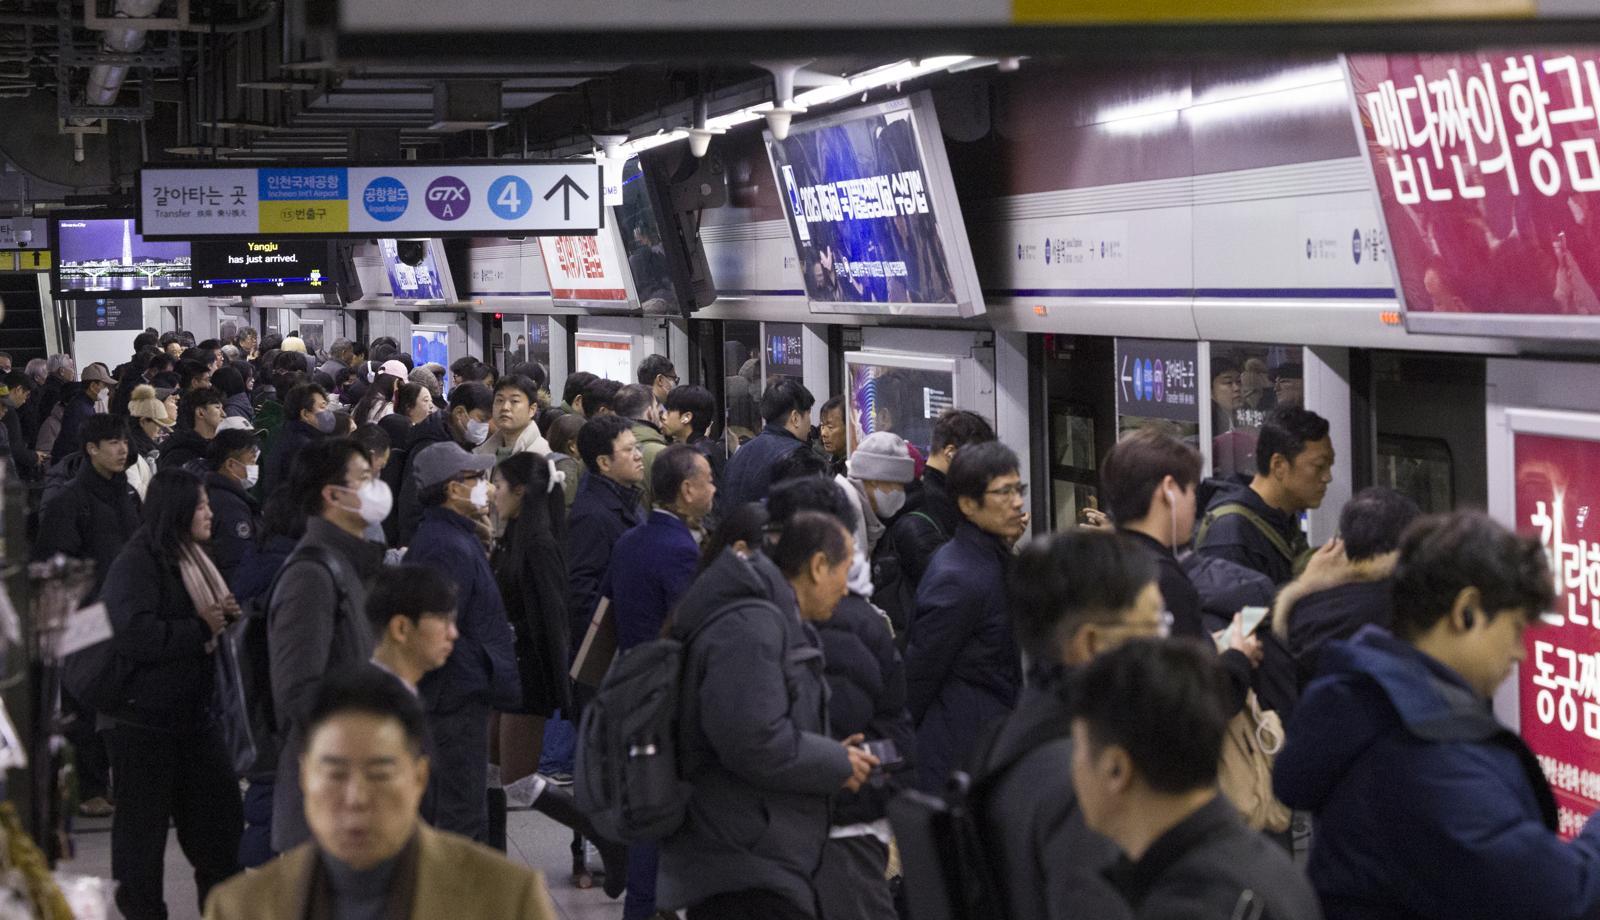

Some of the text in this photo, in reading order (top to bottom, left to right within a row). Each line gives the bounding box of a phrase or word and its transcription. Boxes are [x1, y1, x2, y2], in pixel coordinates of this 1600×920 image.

[1365, 62, 1519, 205] 맵단짠의
[267, 175, 339, 189] 인천국제공항
[153, 186, 247, 206] 갈아타는 곳
[314, 190, 339, 199] Airport
[365, 188, 408, 202] 공항철도
[428, 187, 465, 201] GTX
[496, 181, 521, 213] 4
[155, 209, 191, 218] Transfer
[442, 203, 454, 217] A
[248, 242, 278, 252] Yangju
[228, 254, 298, 265] has just arrived.
